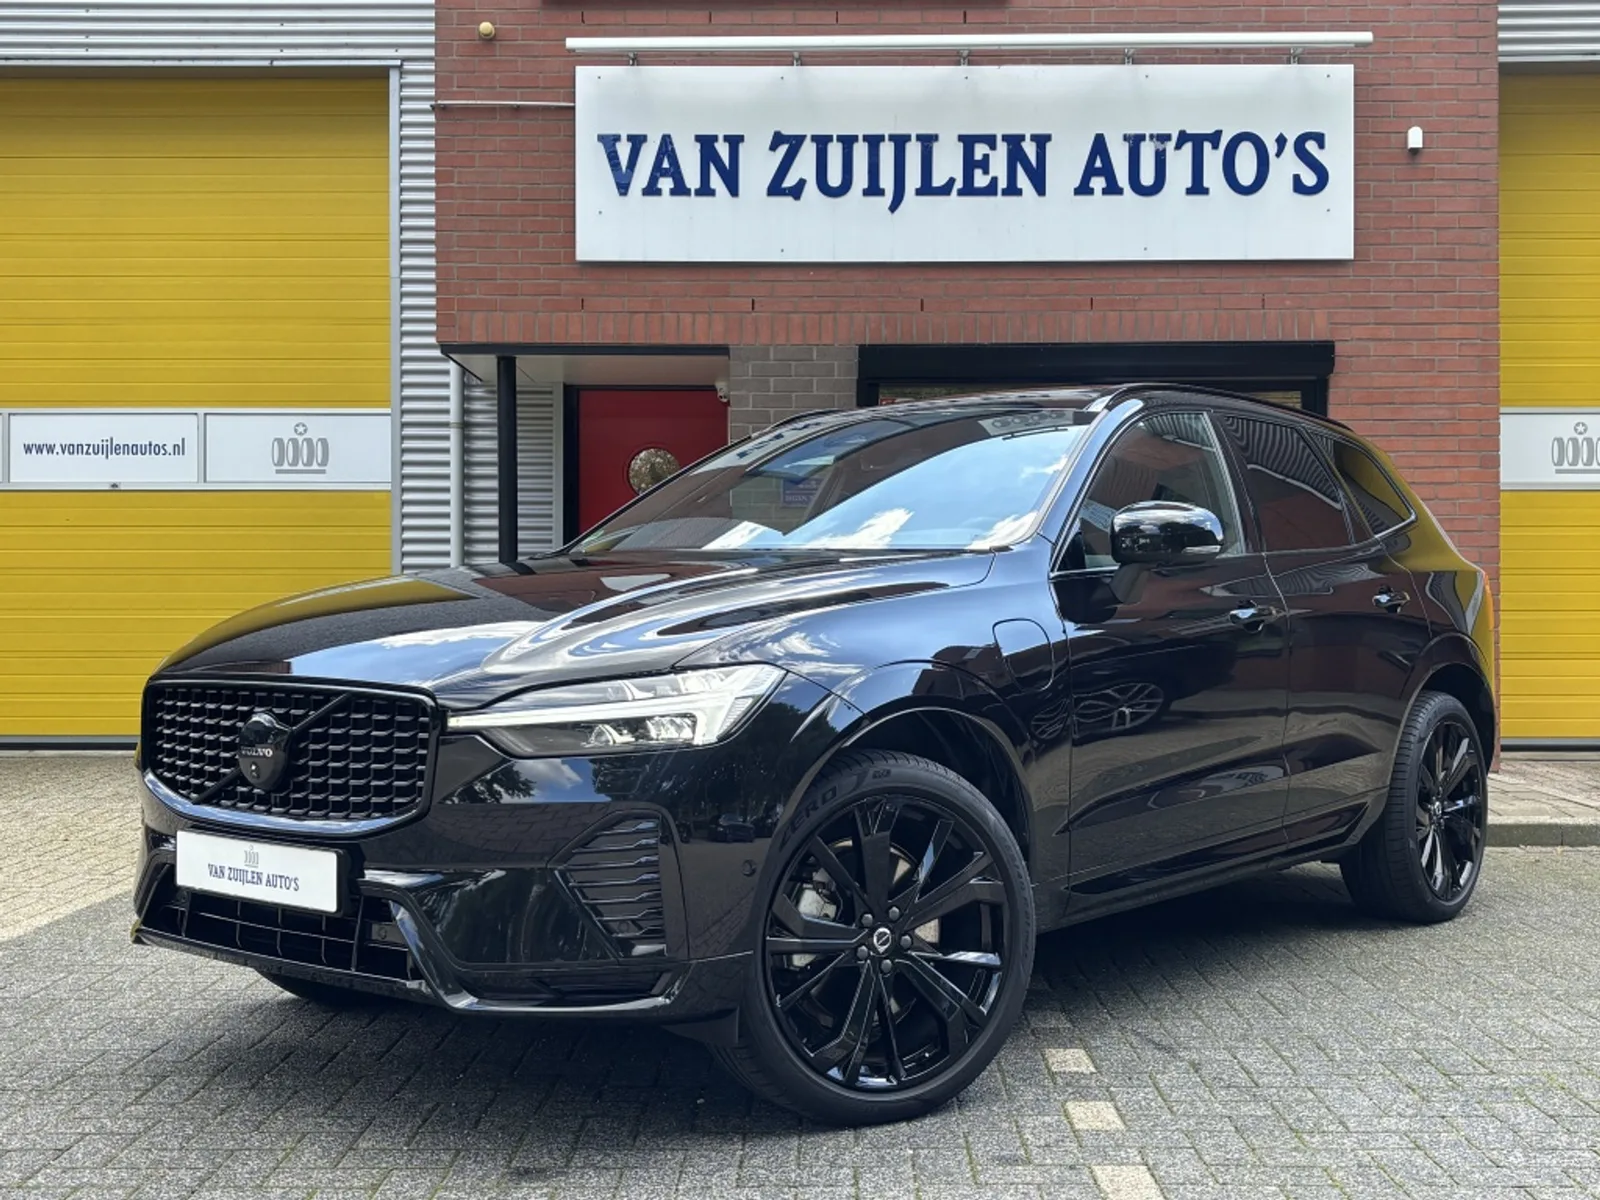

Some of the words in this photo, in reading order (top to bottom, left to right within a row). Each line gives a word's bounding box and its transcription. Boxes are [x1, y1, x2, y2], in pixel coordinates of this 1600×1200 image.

[597, 133, 744, 198] VAN
[767, 130, 1052, 214] ZUIJLEN
[1074, 129, 1330, 197] AUTO'S
[23, 437, 186, 460] www.vanzuijlenautos.nl
[208, 863, 226, 879] VAN
[228, 867, 263, 886] ZUIJLEN
[265, 874, 300, 892] AUTO'S
